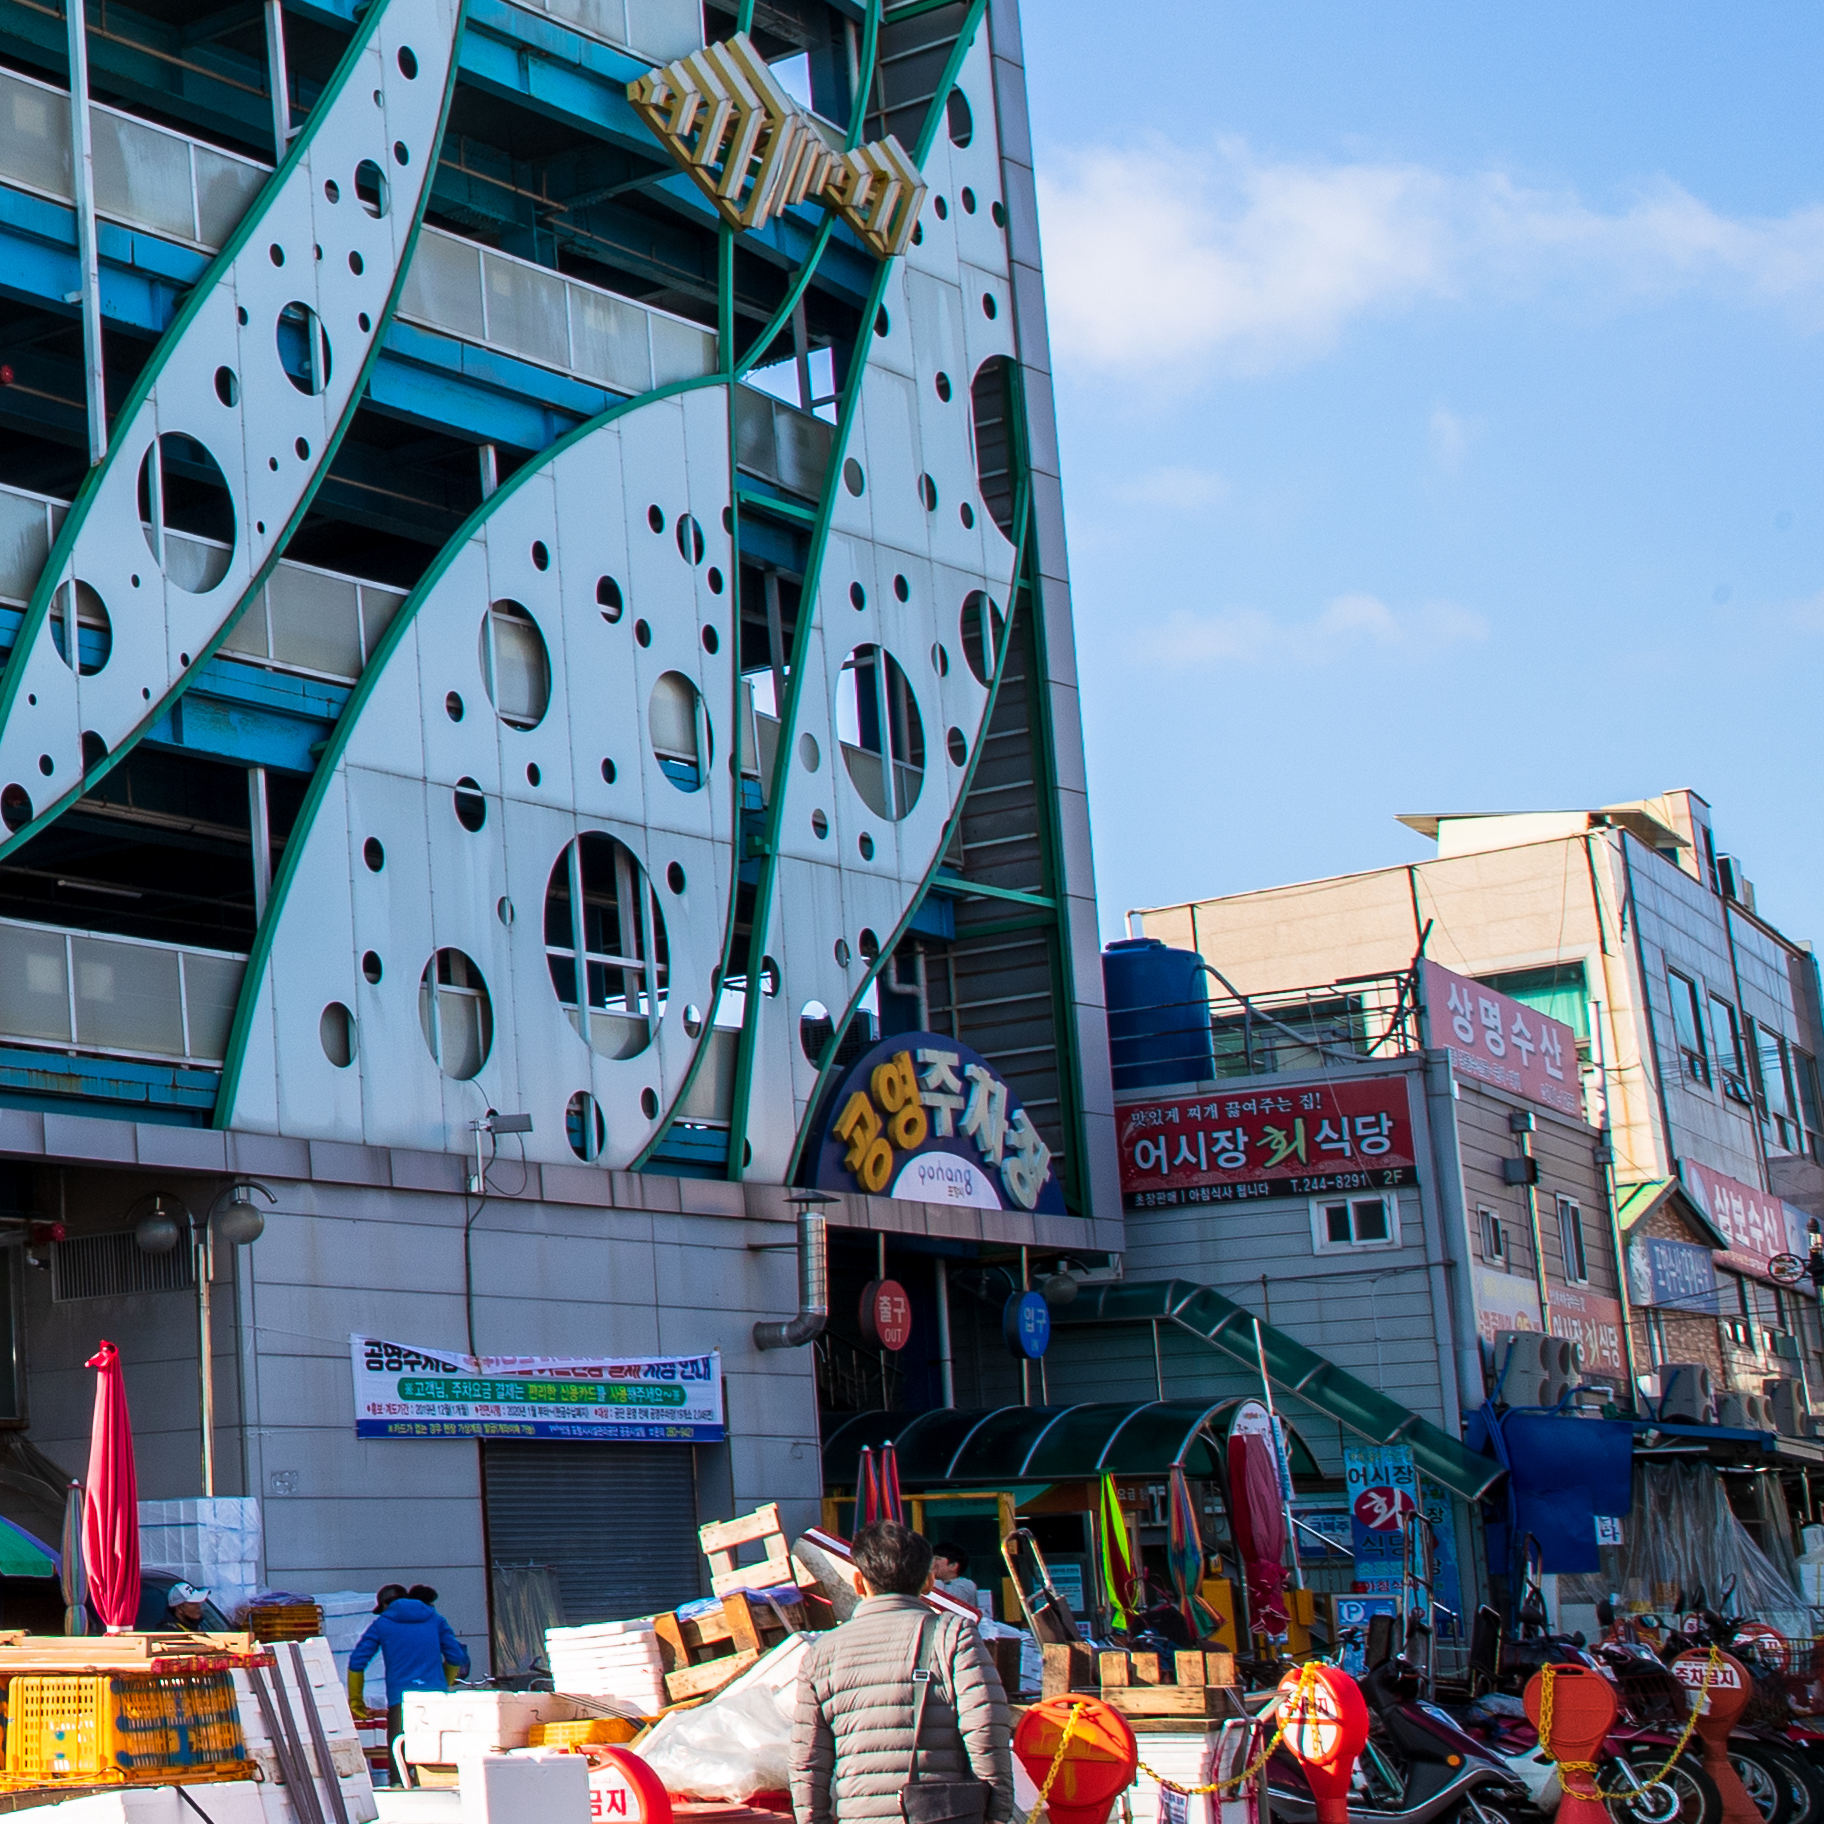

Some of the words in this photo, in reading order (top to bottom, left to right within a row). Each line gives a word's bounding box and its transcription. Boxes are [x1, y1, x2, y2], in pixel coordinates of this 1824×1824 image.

[1447, 982, 1564, 1080] 상명수산
[1131, 1107, 1179, 1127] 맛있게
[1224, 1095, 1293, 1118] 끓여주는
[1299, 1092, 1322, 1111] 집!
[833, 1048, 1051, 1209] 공영주차장
[1134, 1127, 1250, 1174] 어시장
[1384, 1169, 1403, 1184] 2F
[879, 1295, 906, 1324] 출구
[1024, 1306, 1047, 1334] 입구
[884, 1327, 903, 1343] OUT
[451, 1381, 492, 1400] 주차요금
[495, 1382, 525, 1400] 결제는
[1347, 1465, 1414, 1486] 어시장
[1675, 1666, 1735, 1686] 주차금지
